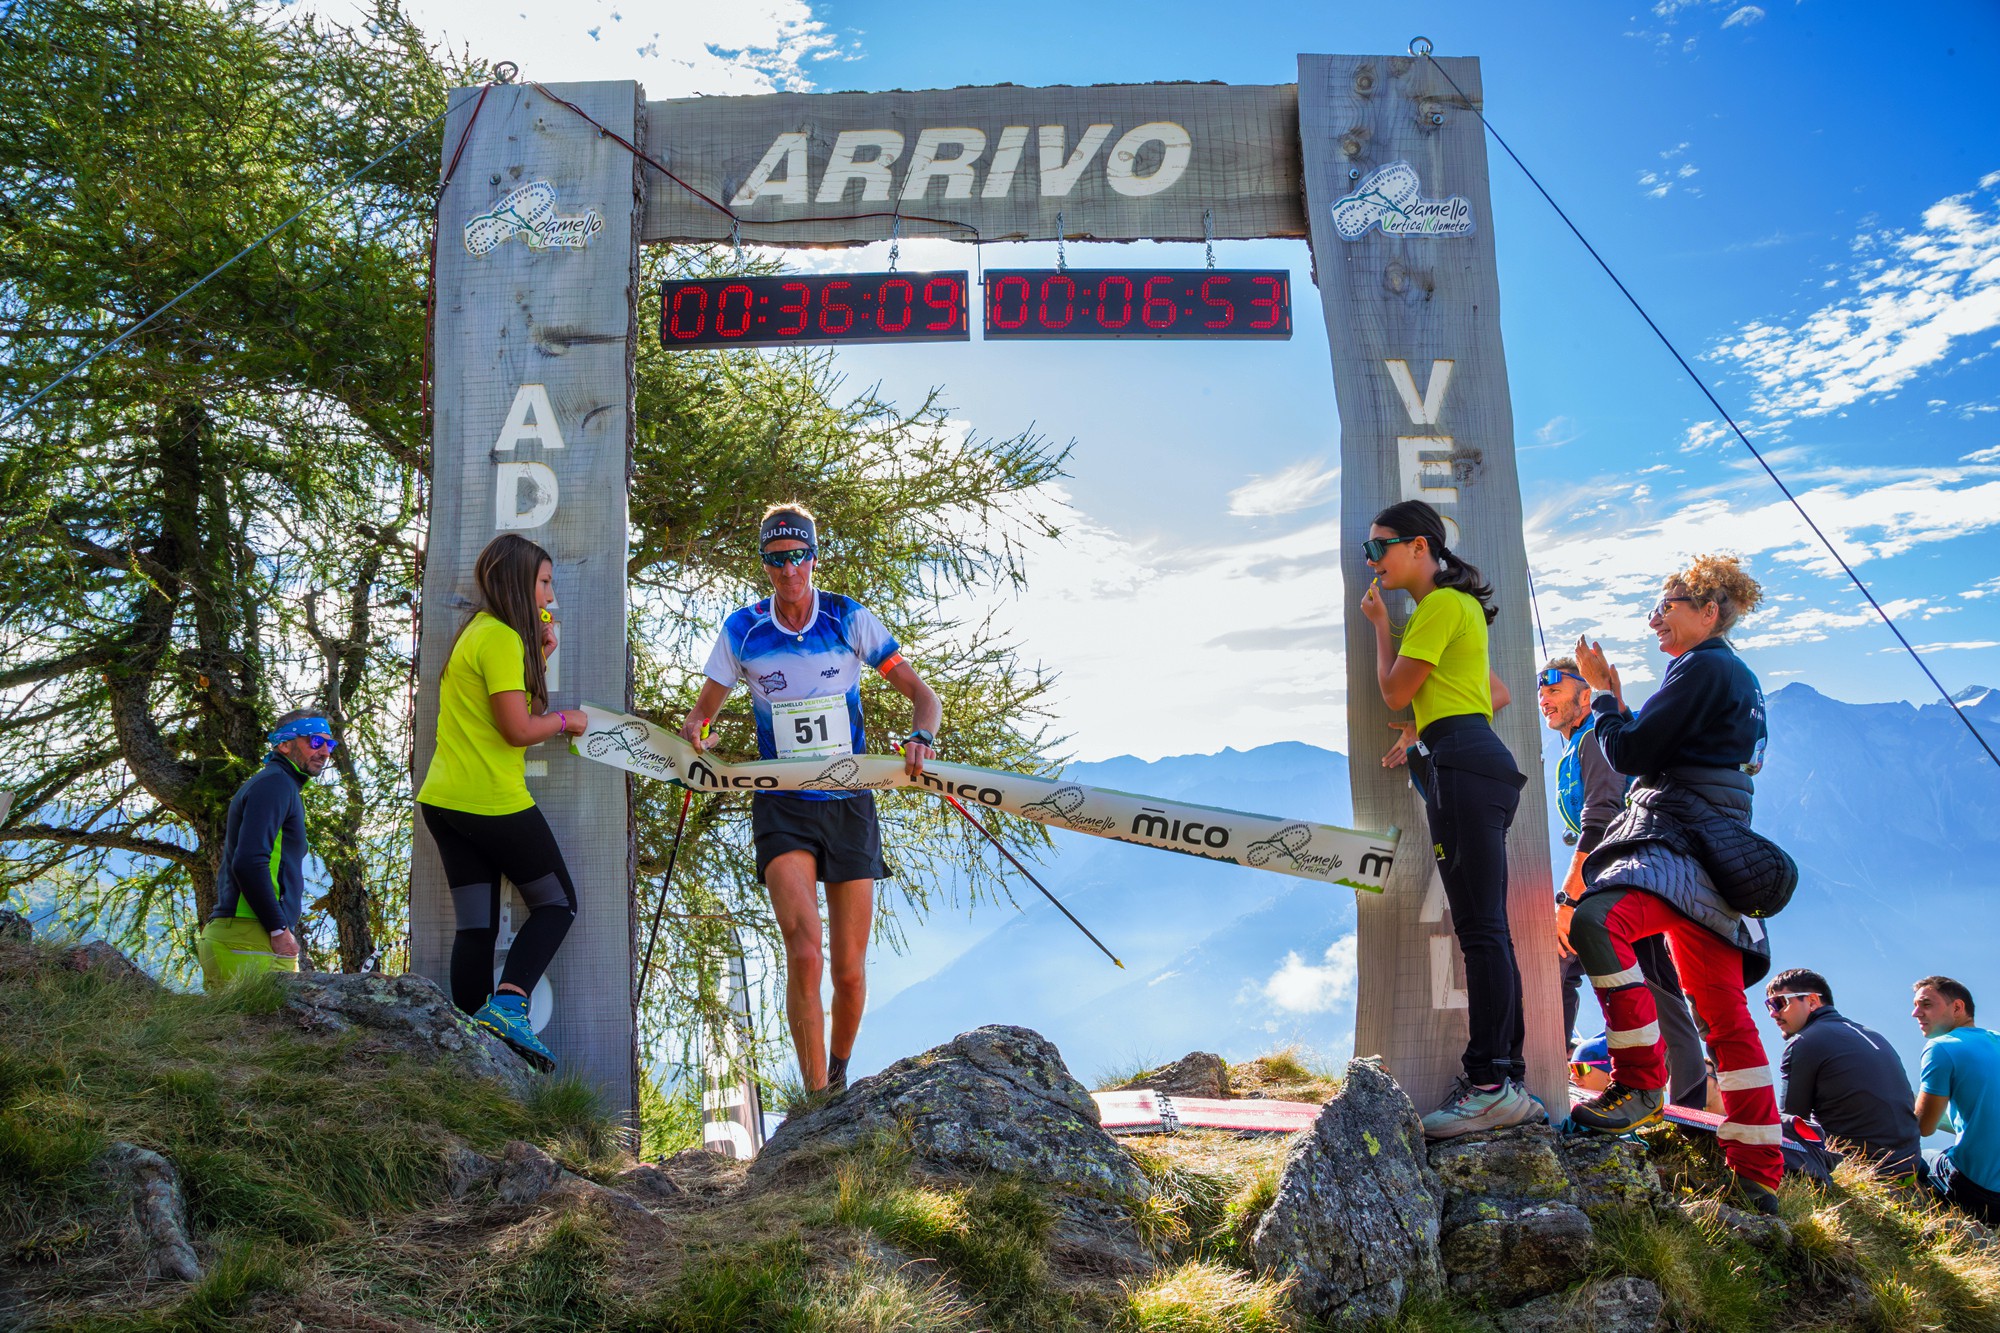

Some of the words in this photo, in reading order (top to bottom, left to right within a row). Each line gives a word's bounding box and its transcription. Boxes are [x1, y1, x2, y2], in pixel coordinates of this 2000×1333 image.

[730, 121, 1192, 207] ARRIVO
[670, 277, 958, 339] 00:36:09
[992, 276, 1281, 329] 00:06:53
[762, 527, 809, 542] SUUNTO
[773, 701, 803, 709] ADAMELLO
[794, 714, 828, 744] 51
